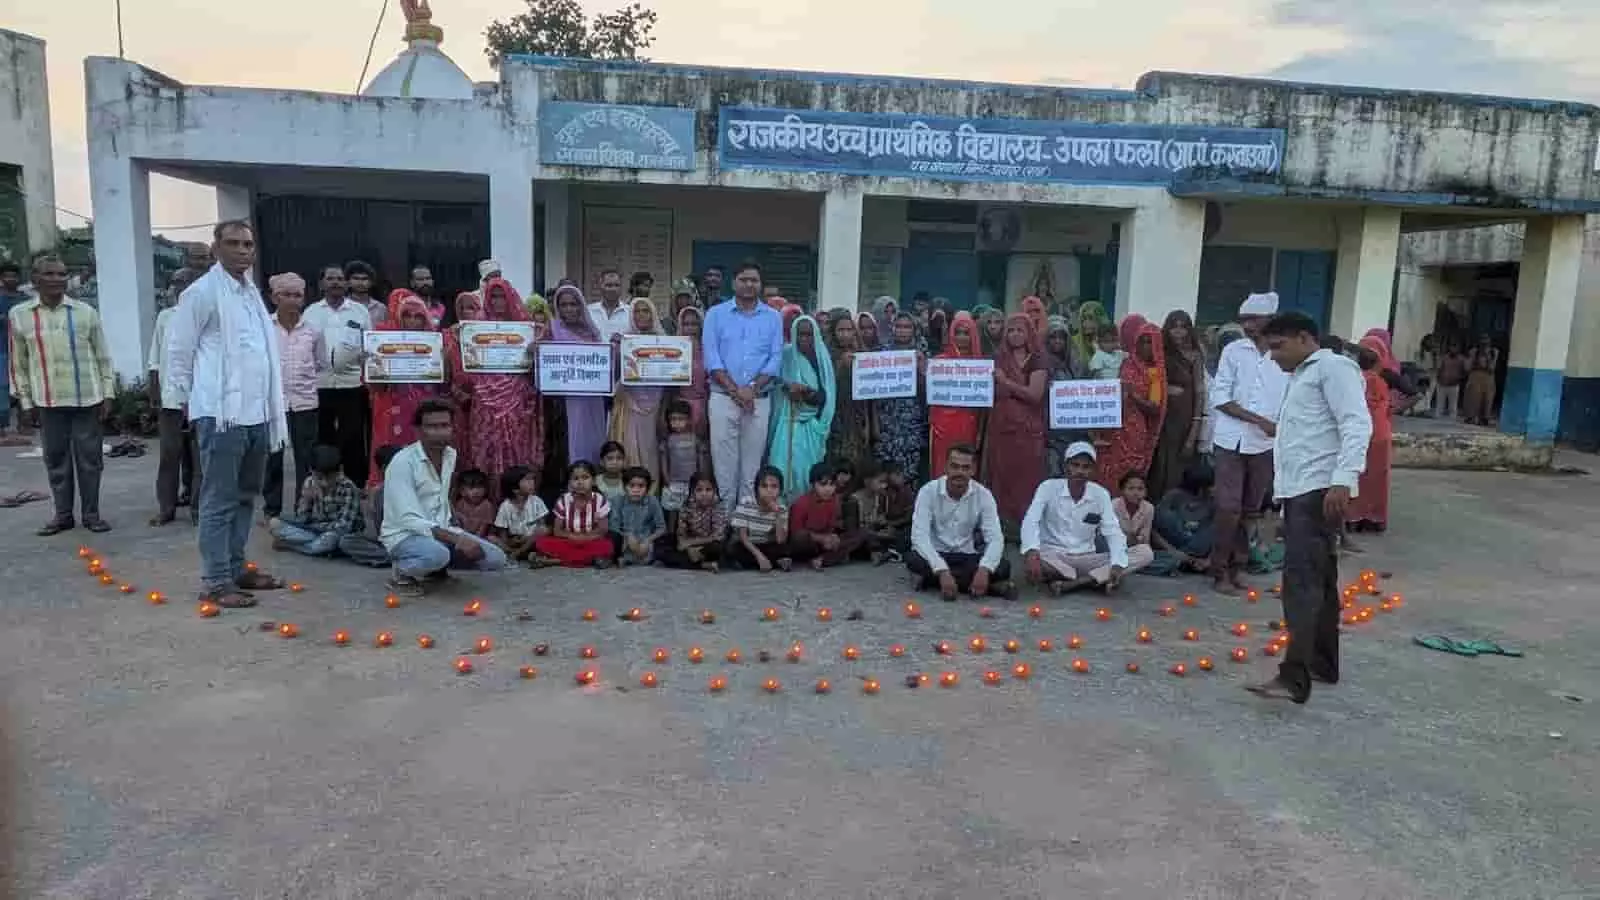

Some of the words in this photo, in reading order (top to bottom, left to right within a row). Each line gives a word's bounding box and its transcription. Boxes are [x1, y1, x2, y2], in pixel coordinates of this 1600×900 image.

[727, 114, 823, 150] राजकीय
[823, 123, 867, 154] उच्च
[867, 121, 952, 158] प्राथमिक
[1053, 136, 1110, 167] उपला
[1112, 138, 1162, 168] फला
